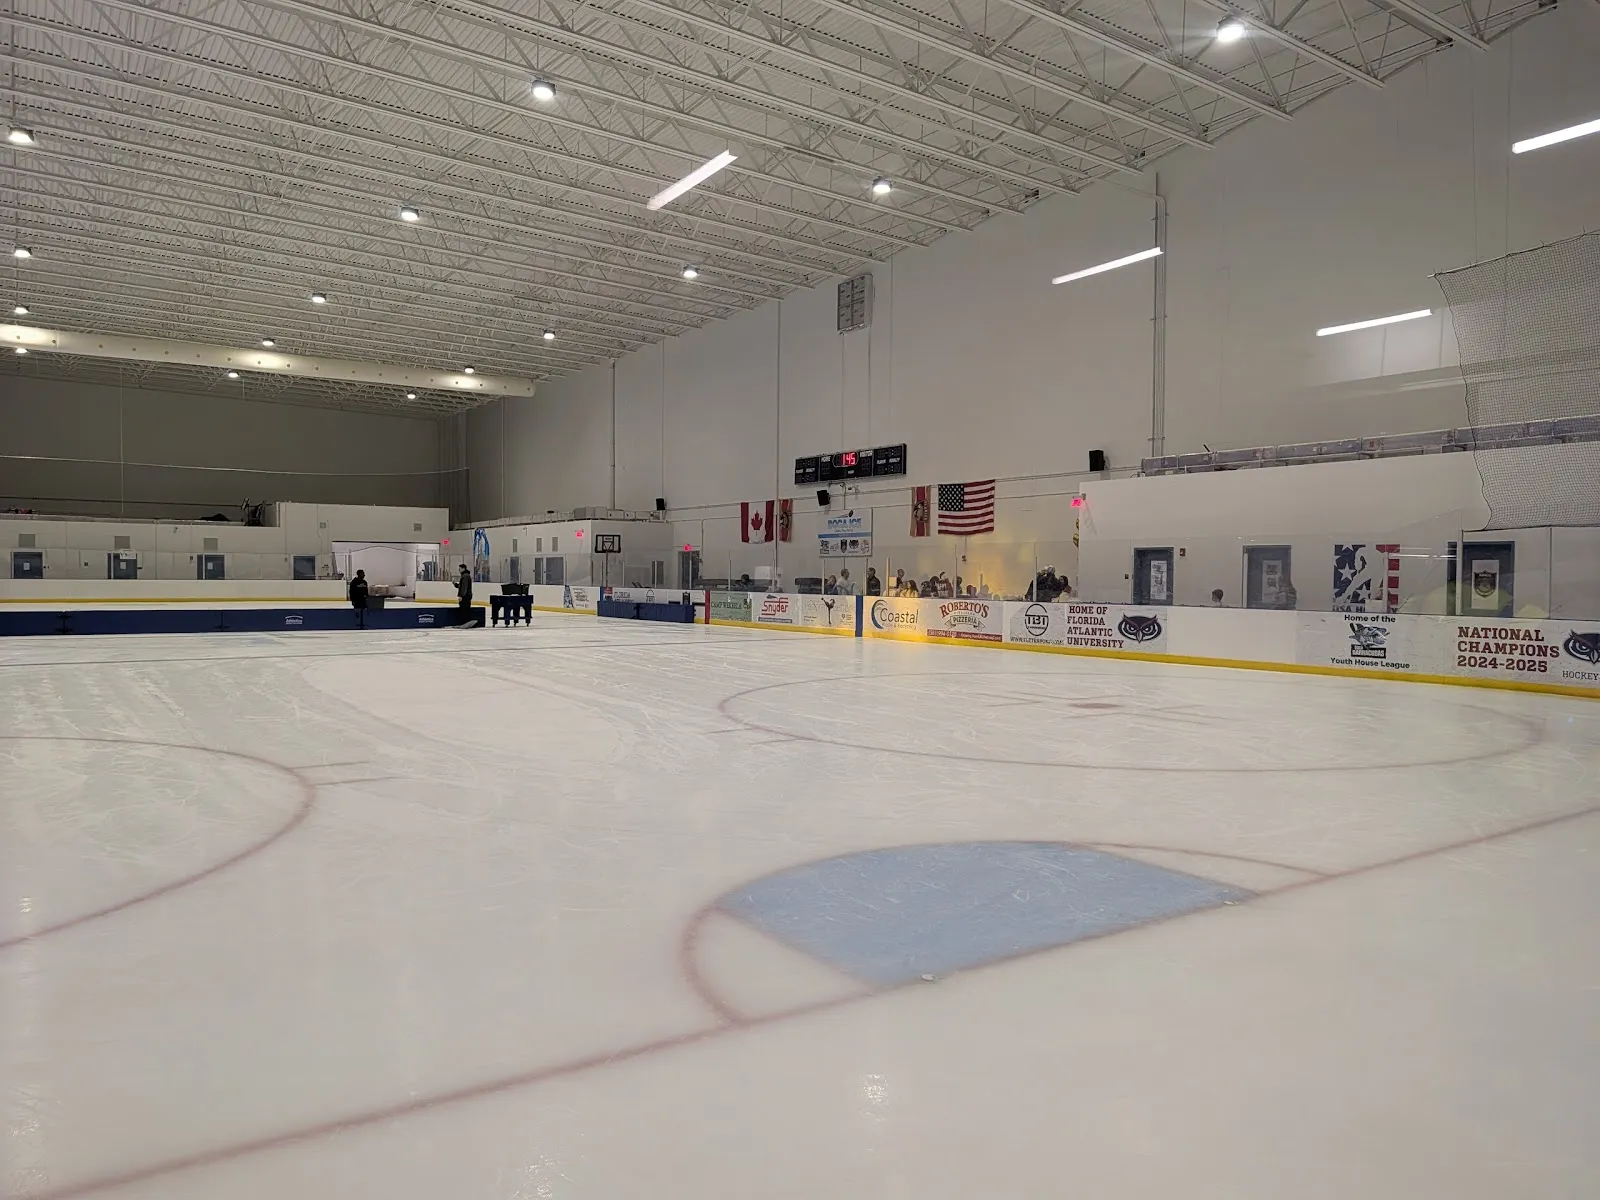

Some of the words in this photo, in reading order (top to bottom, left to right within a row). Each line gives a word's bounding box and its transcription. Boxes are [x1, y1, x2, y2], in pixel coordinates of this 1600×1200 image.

[761, 597, 789, 616] Snyder
[940, 601, 990, 618] ROBERTO'S
[1068, 605, 1094, 615] HOME
[1096, 606, 1108, 615] OF
[880, 607, 919, 624] Coastal
[952, 616, 978, 625] PIZZERIA
[1067, 616, 1106, 626] FLORIDA
[1344, 614, 1369, 622] Home
[1370, 614, 1379, 622] of
[1381, 615, 1396, 623] the
[1067, 626, 1113, 637] ATLANTIC
[1457, 626, 1545, 642] NATIONAL
[1067, 637, 1125, 648] UNIVERSITY
[1457, 641, 1560, 658] CHAMPIONS
[1330, 657, 1353, 665] Youth
[1354, 659, 1379, 667] House
[1380, 660, 1410, 669] League
[1457, 655, 1548, 673] 2024-2025
[1562, 670, 1599, 681] HOCKEY
